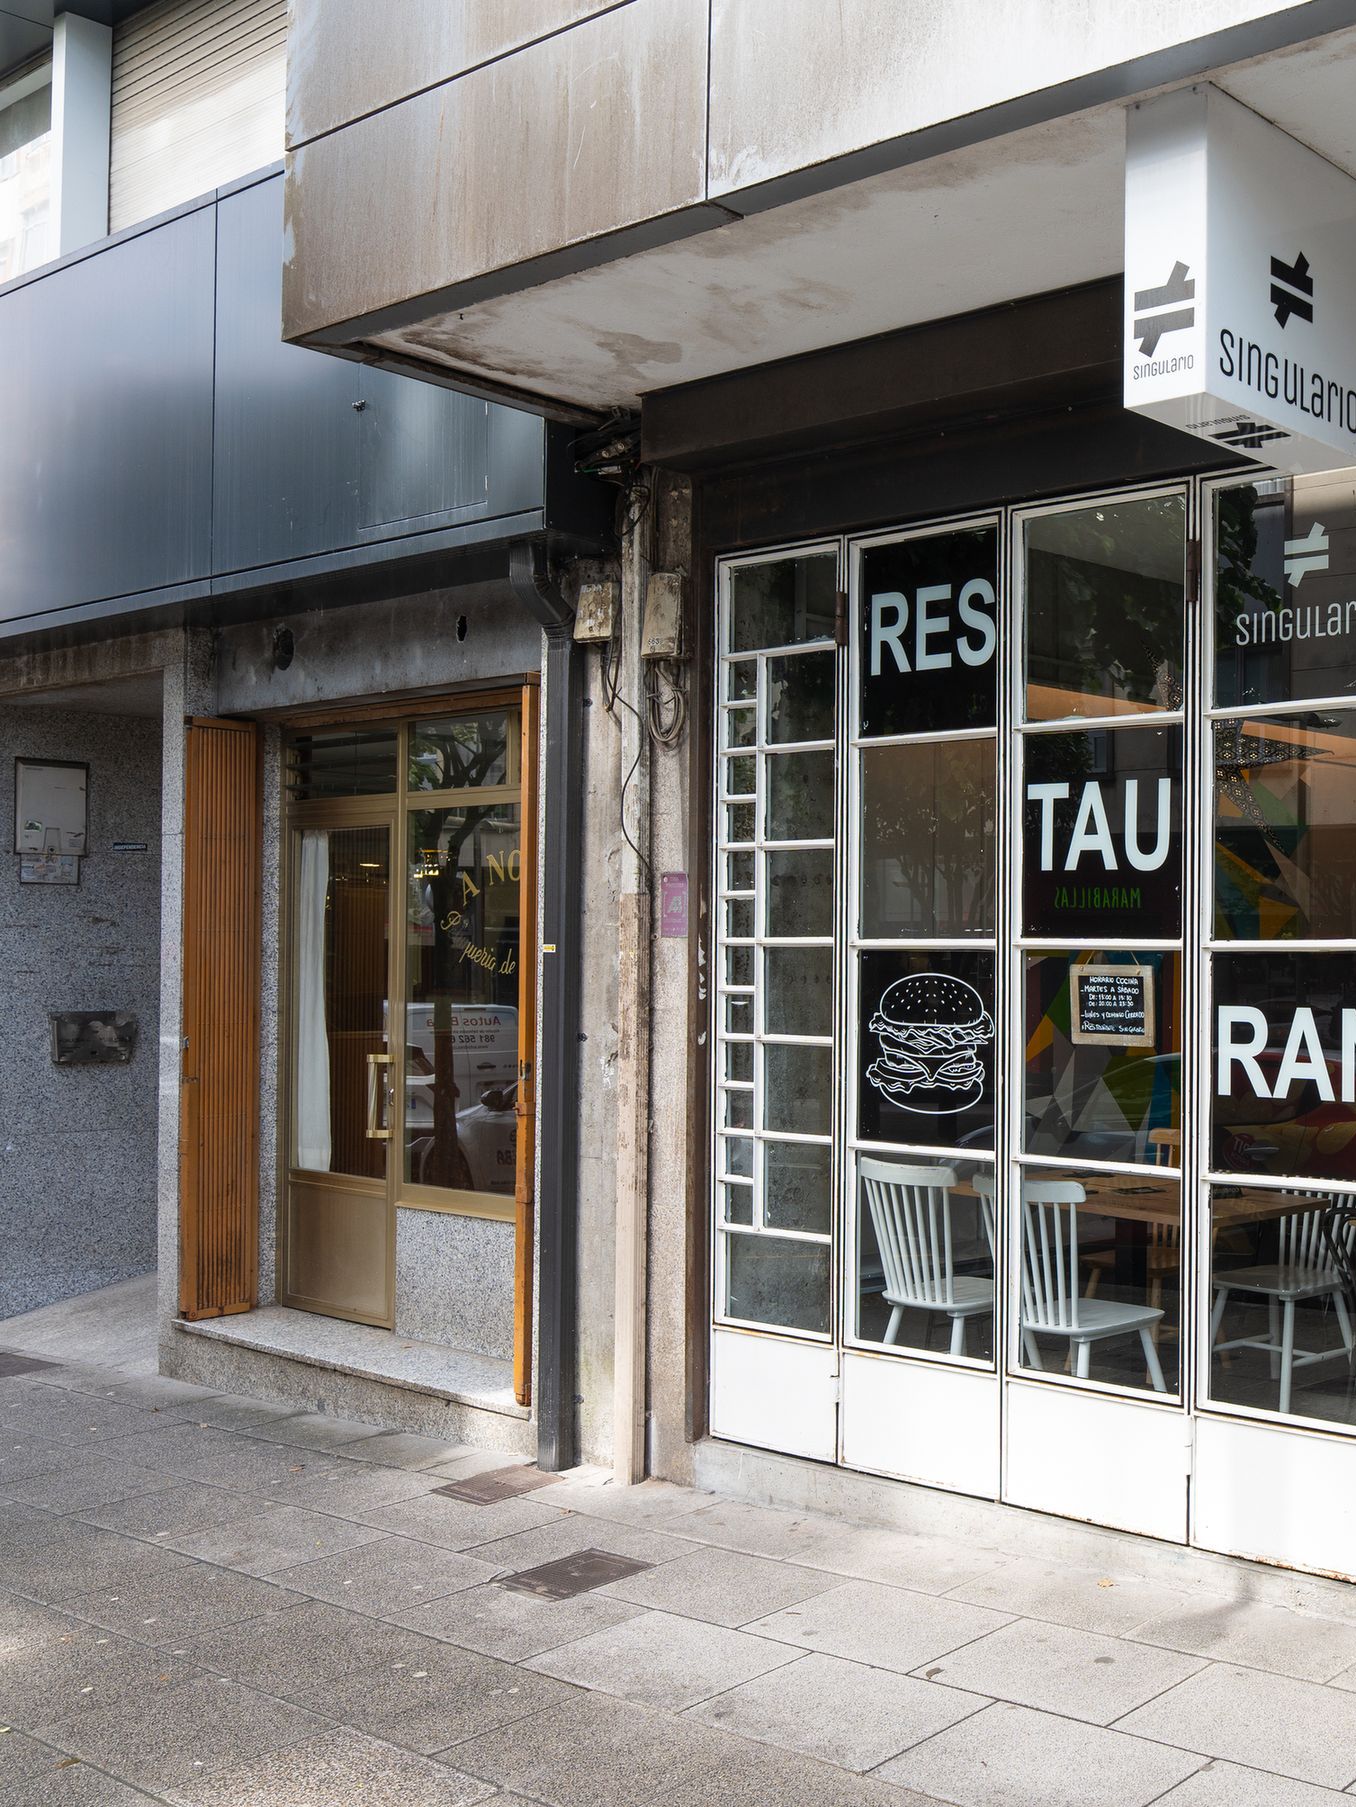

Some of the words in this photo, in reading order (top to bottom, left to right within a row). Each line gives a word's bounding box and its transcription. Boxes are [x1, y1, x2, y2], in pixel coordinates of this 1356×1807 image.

[870, 578, 996, 676] RES
[1027, 778, 1171, 872] TAU
[463, 871, 480, 906] A
[1089, 976, 1114, 984] HORARIO
[1115, 976, 1139, 985] COCINA
